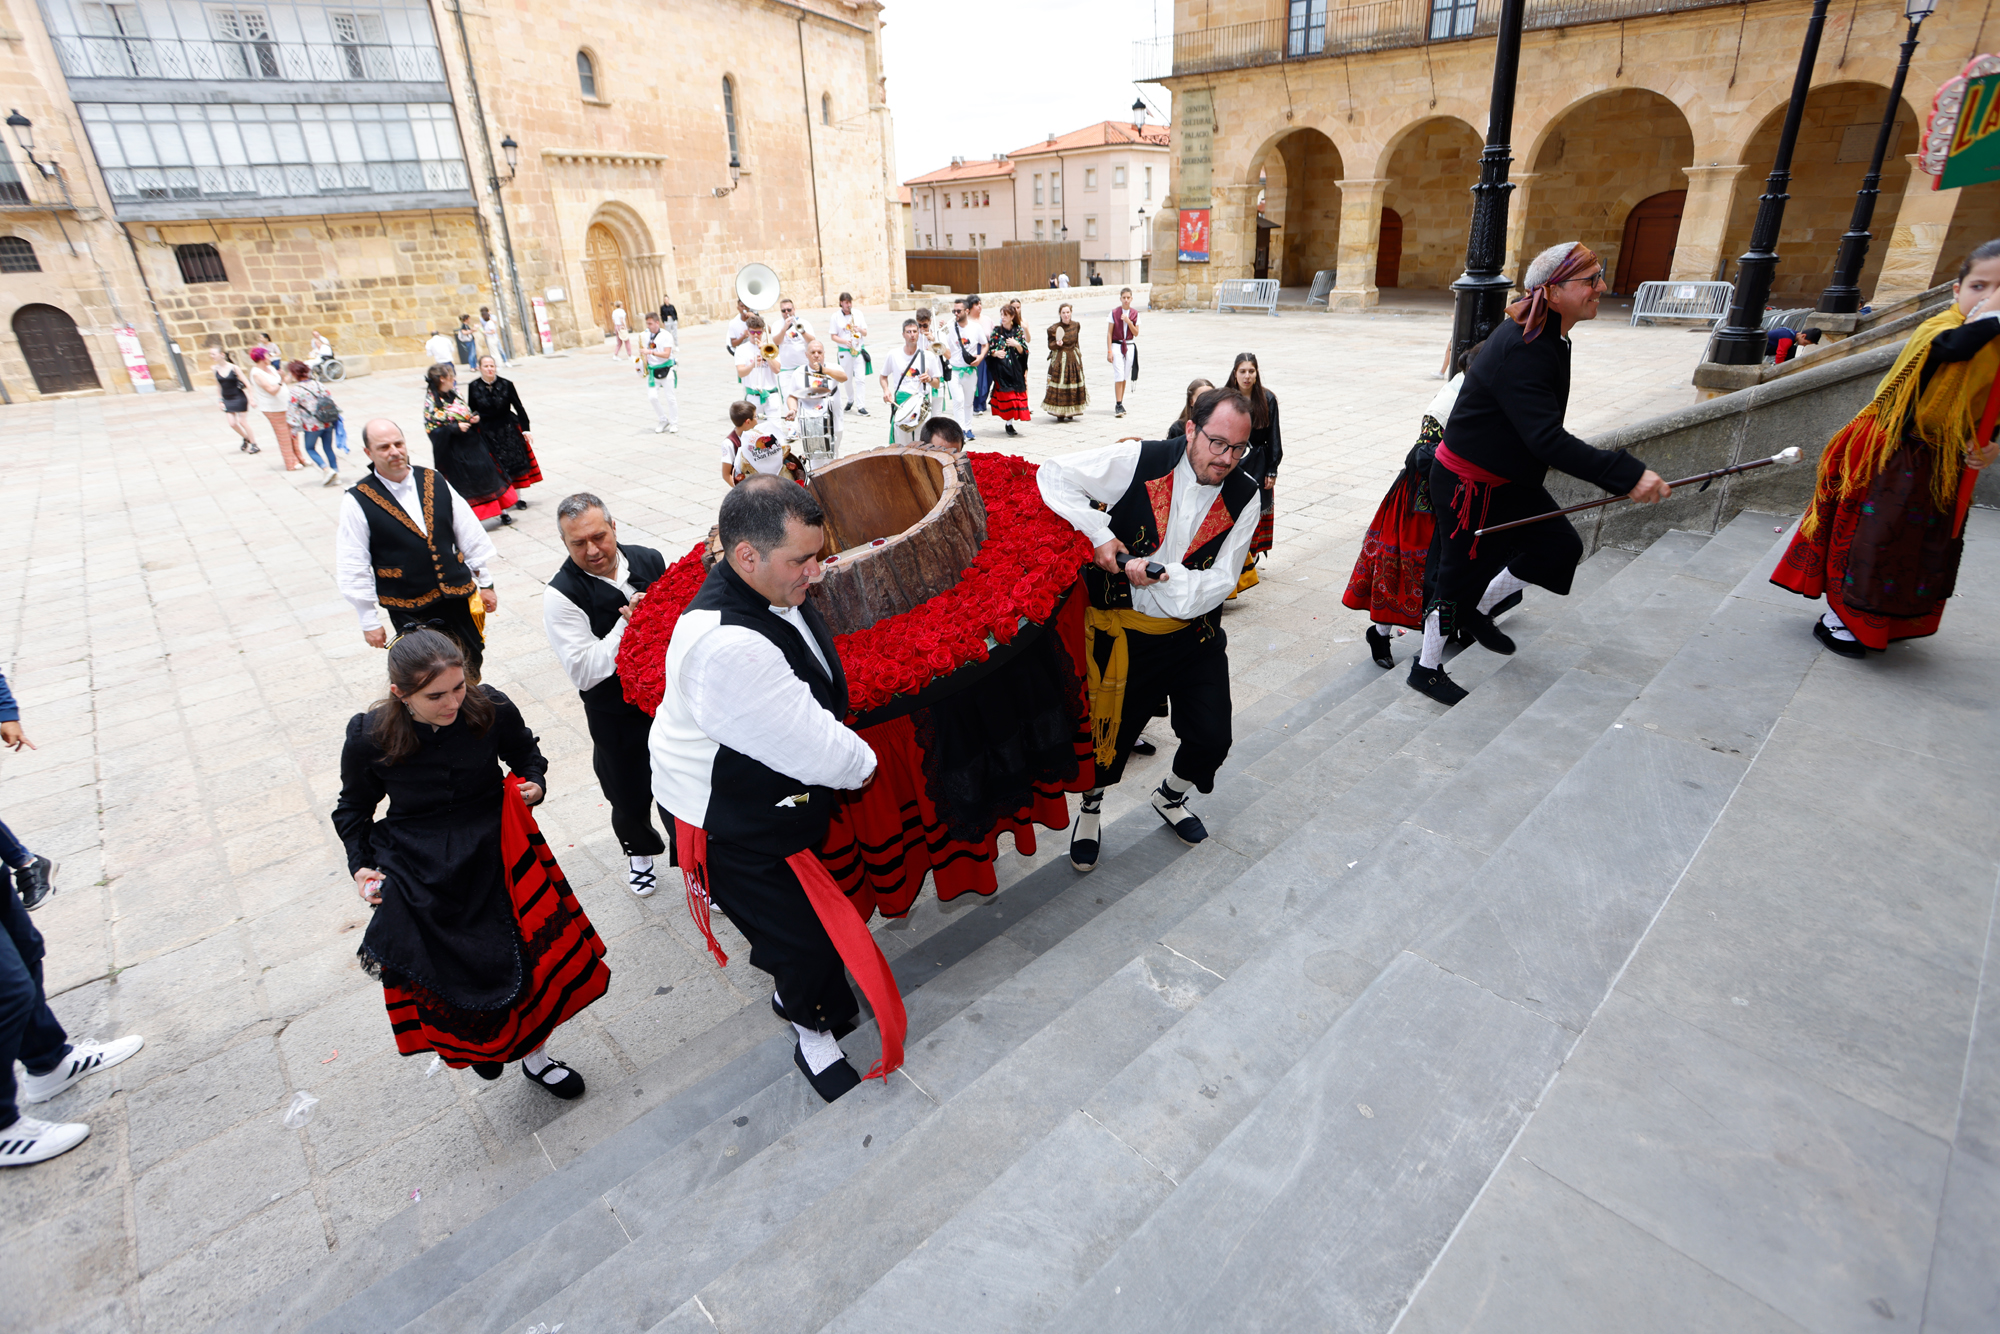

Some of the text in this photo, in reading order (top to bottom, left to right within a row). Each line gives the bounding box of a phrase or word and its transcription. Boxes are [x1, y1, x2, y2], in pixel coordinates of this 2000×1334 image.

[1185, 104, 1210, 113] CENTRO
[1181, 117, 1211, 126] CULTURAL
[1184, 131, 1209, 139] PALACIO
[1181, 156, 1211, 165] AUDIENCIA
